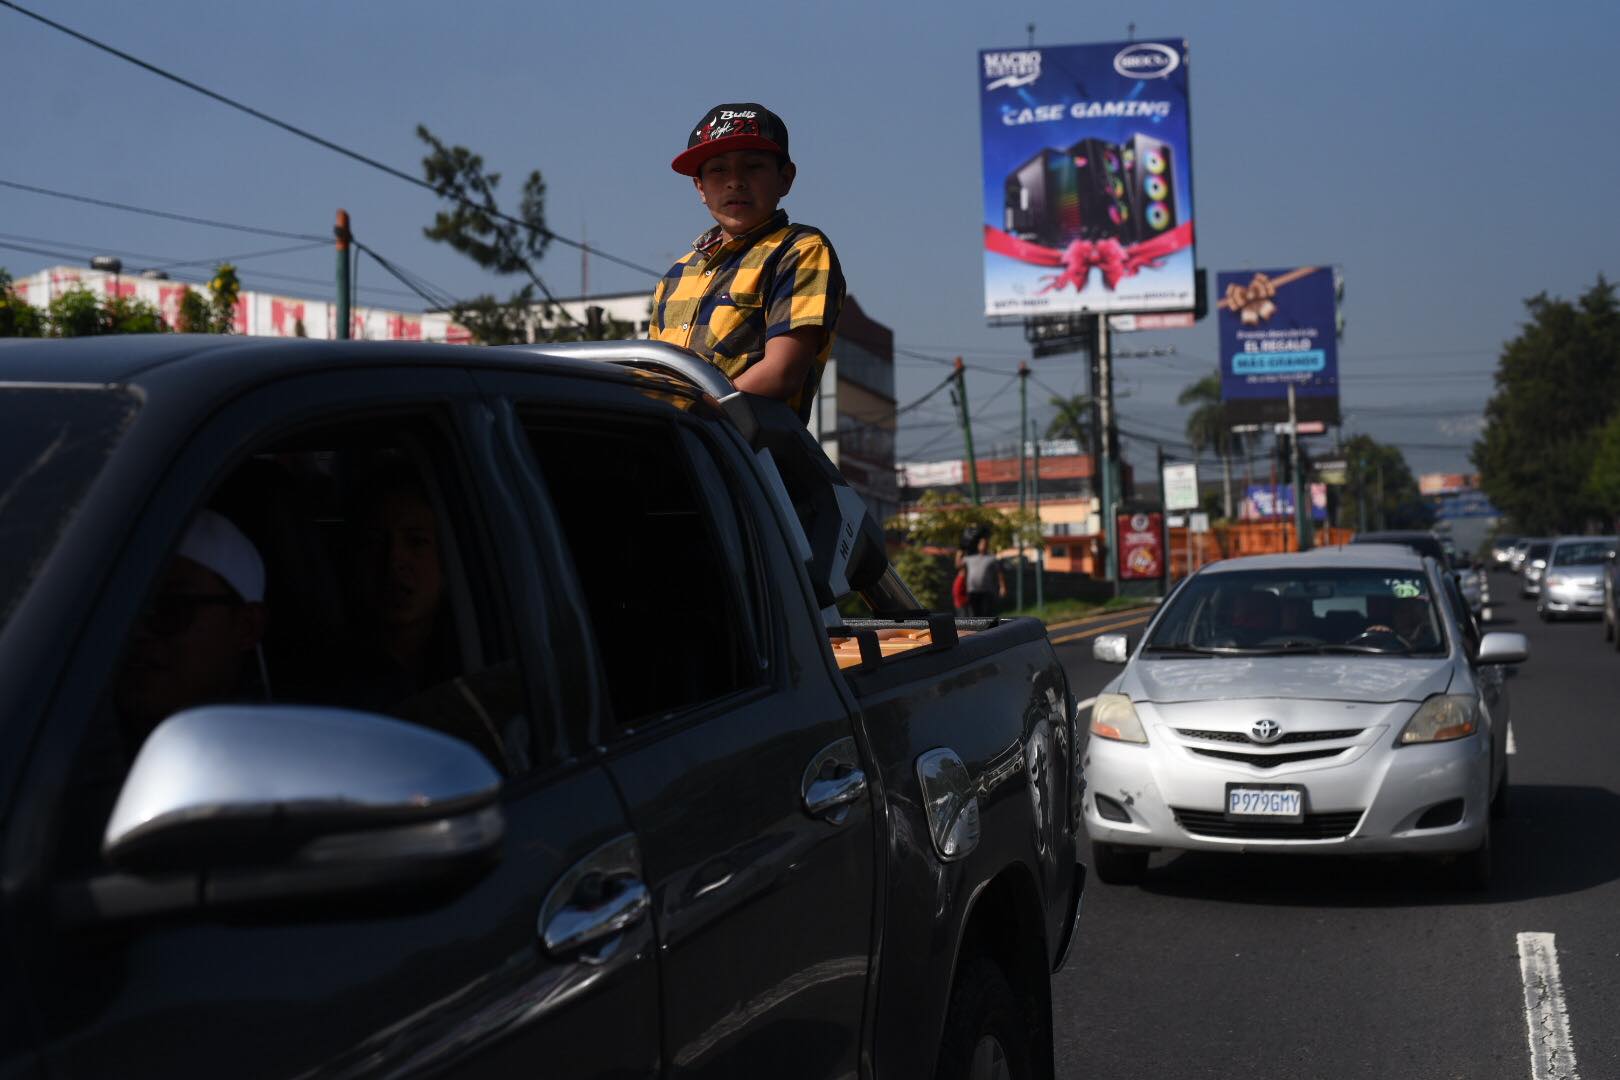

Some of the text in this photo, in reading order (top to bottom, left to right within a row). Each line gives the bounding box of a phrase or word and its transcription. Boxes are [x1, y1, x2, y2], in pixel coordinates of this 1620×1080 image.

[720, 110, 757, 120] Bulls
[1002, 101, 1171, 125] CASE GAMING
[733, 119, 759, 136] 23
